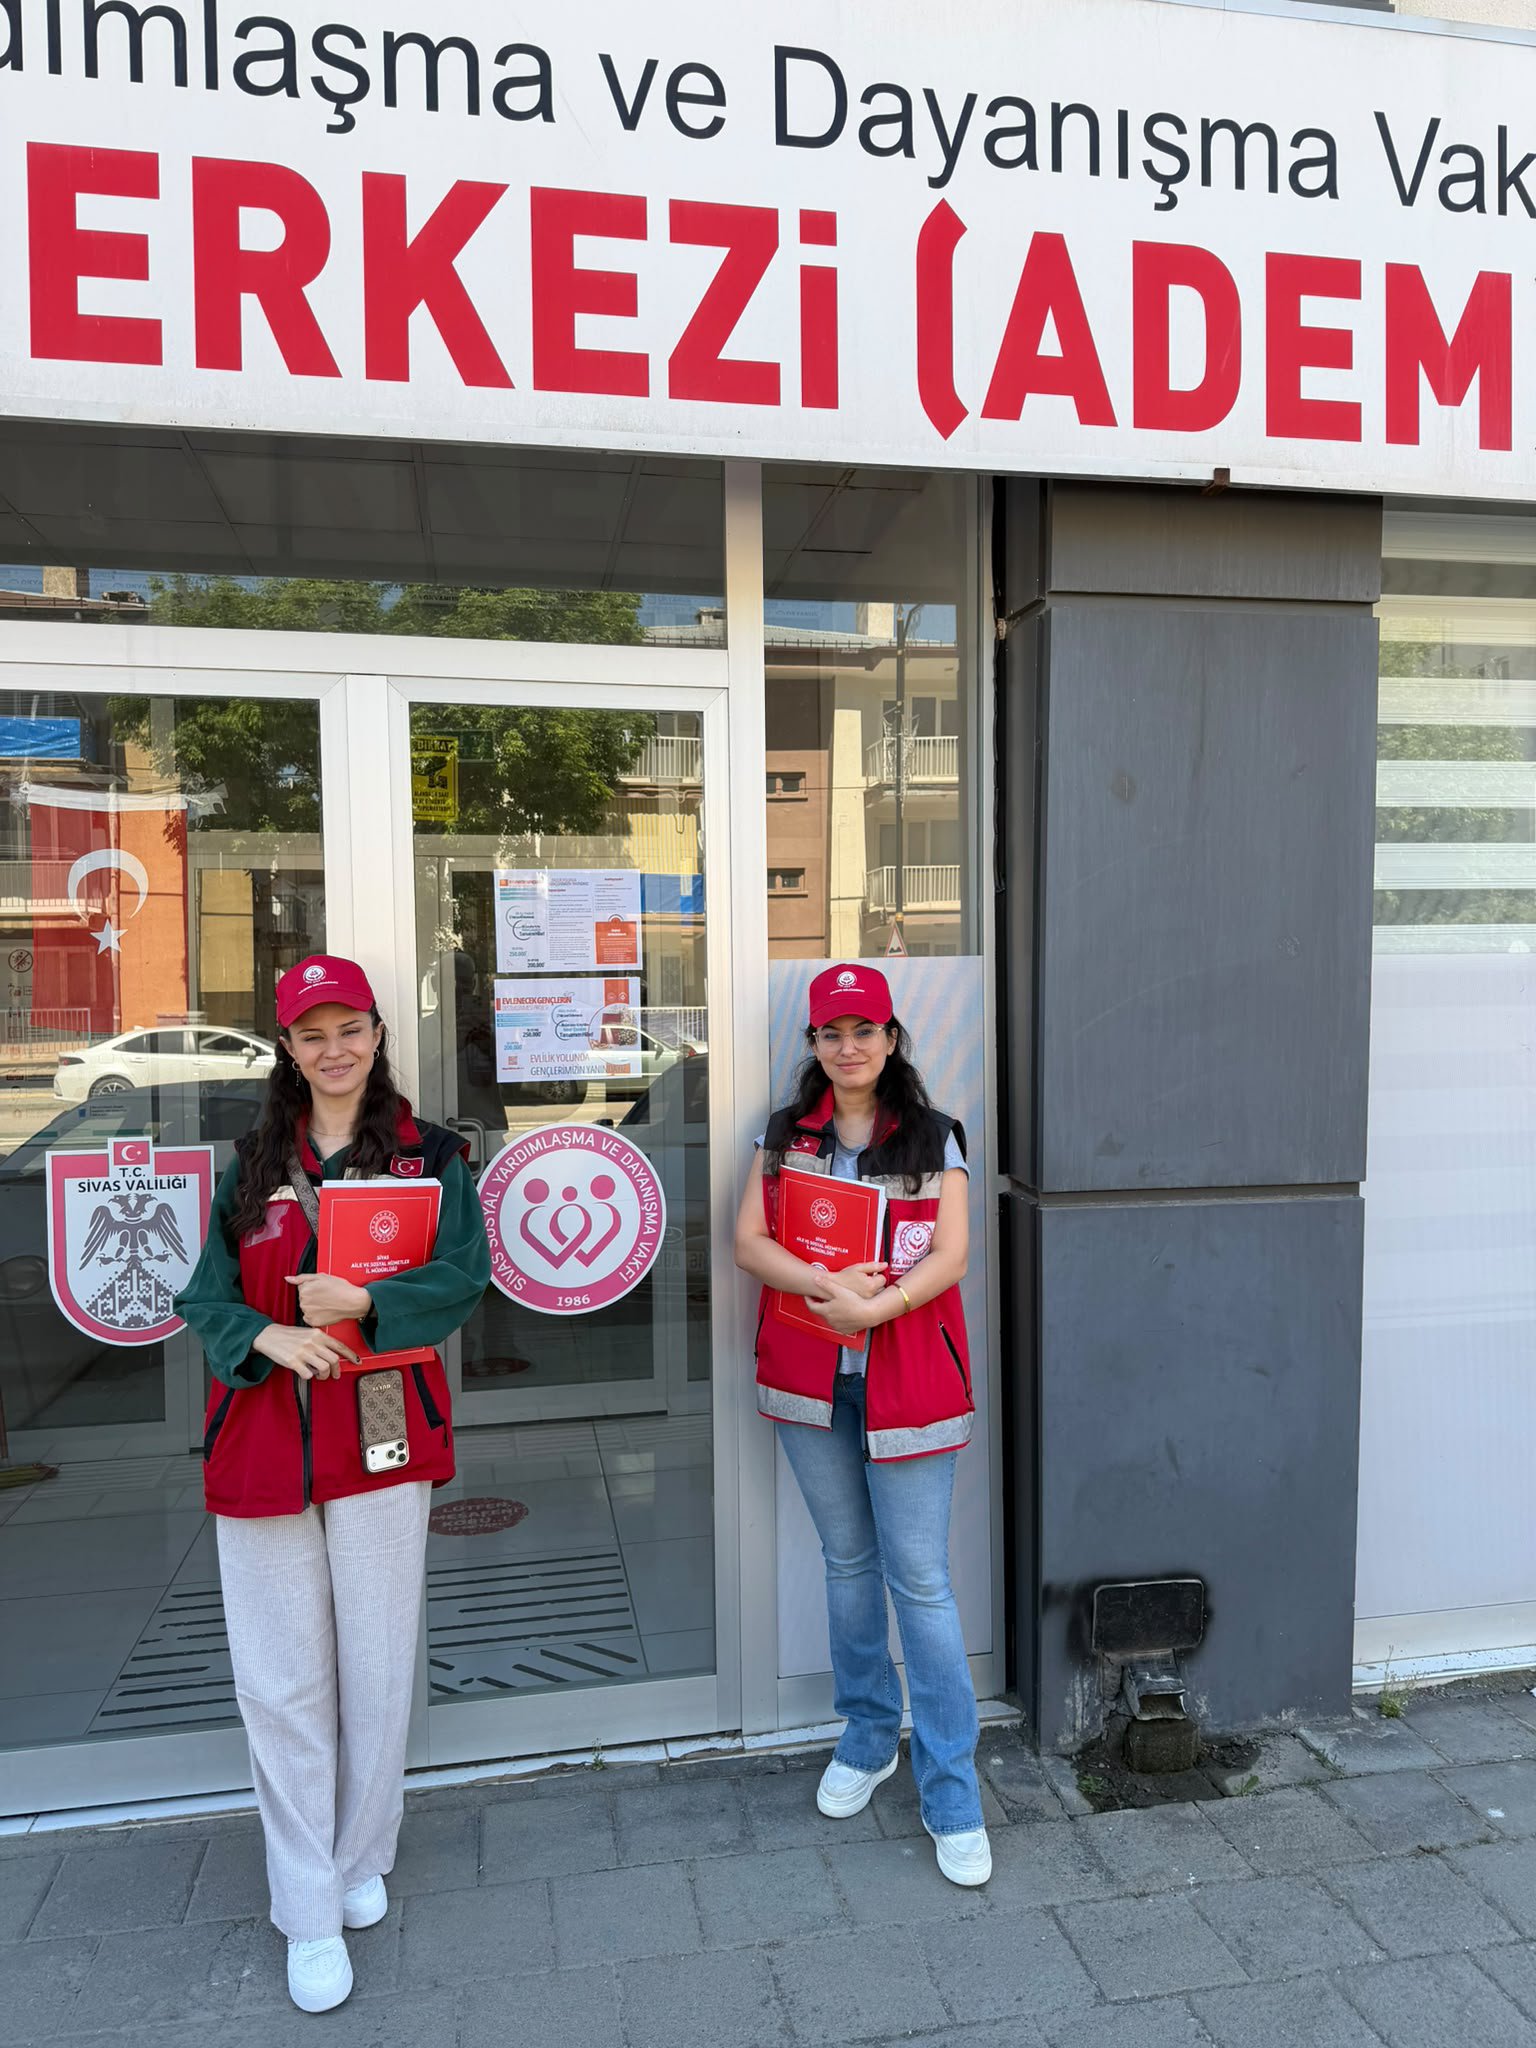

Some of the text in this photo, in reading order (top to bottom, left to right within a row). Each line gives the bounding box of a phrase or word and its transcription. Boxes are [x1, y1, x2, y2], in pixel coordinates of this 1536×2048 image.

[599, 54, 727, 139] ve
[774, 45, 1339, 212] Dayanışma
[915, 199, 1512, 451] (ADEM
[530, 1052, 590, 1063] EVLİLİK YOLUNDA
[531, 1063, 585, 1077] GENÇLERİMİZİN
[492, 1130, 595, 1184] YARDIMLAŞMA
[601, 1138, 622, 1158] VE
[78, 1175, 187, 1193] SİVAS VALİLİĞİ
[119, 1167, 146, 1178] T.C.
[620, 1153, 658, 1236] DAYANIŞMA
[492, 1252, 527, 1292] SİVAS
[619, 1242, 653, 1283] VAKFI
[556, 1294, 591, 1307] 1986
